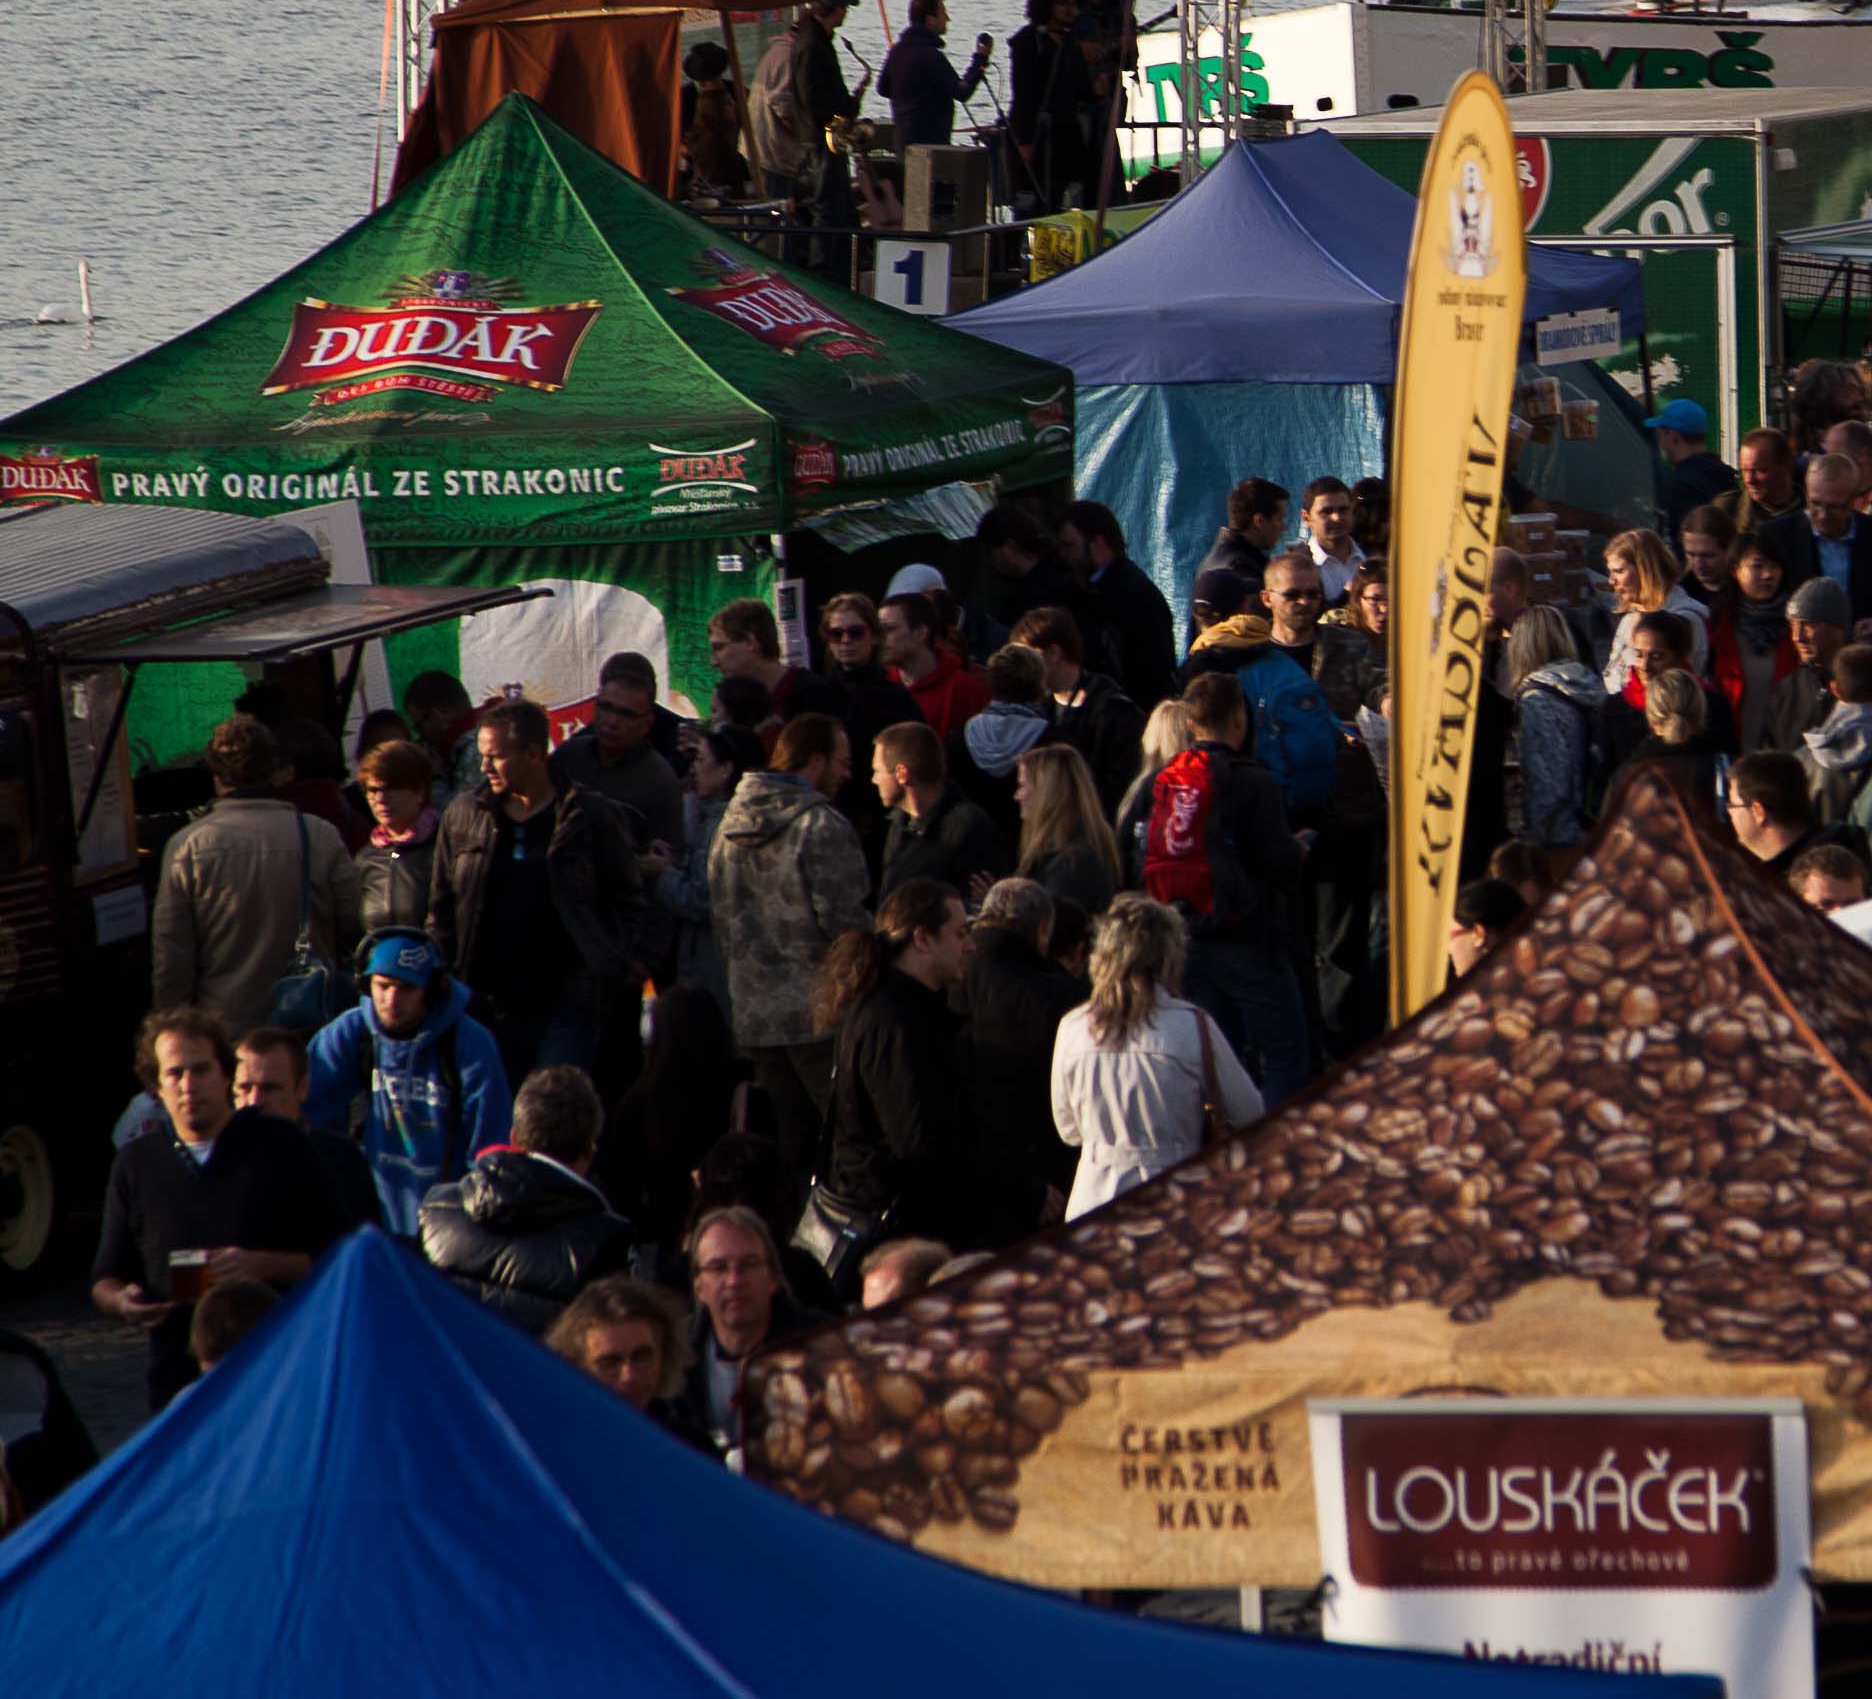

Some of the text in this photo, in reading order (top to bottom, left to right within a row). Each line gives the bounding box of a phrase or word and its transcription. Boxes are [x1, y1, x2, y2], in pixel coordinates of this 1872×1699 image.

[1147, 32, 1270, 122] TYRŠ
[895, 250, 923, 306] 1
[842, 418, 1028, 478] PRAVÝ ORIGINÁL ZE STRAKONIC
[112, 466, 625, 500] PRAVÝ ORIGINÁL ZE STRAKONIC
[1121, 1461, 1280, 1491] PRAŽENÁ
[1365, 1447, 1752, 1534] LOUSKÁČEK
[1157, 1499, 1251, 1530] KÁVA
[1492, 1546, 1563, 1575] pravé
[1573, 1546, 1689, 1573] ořechové
